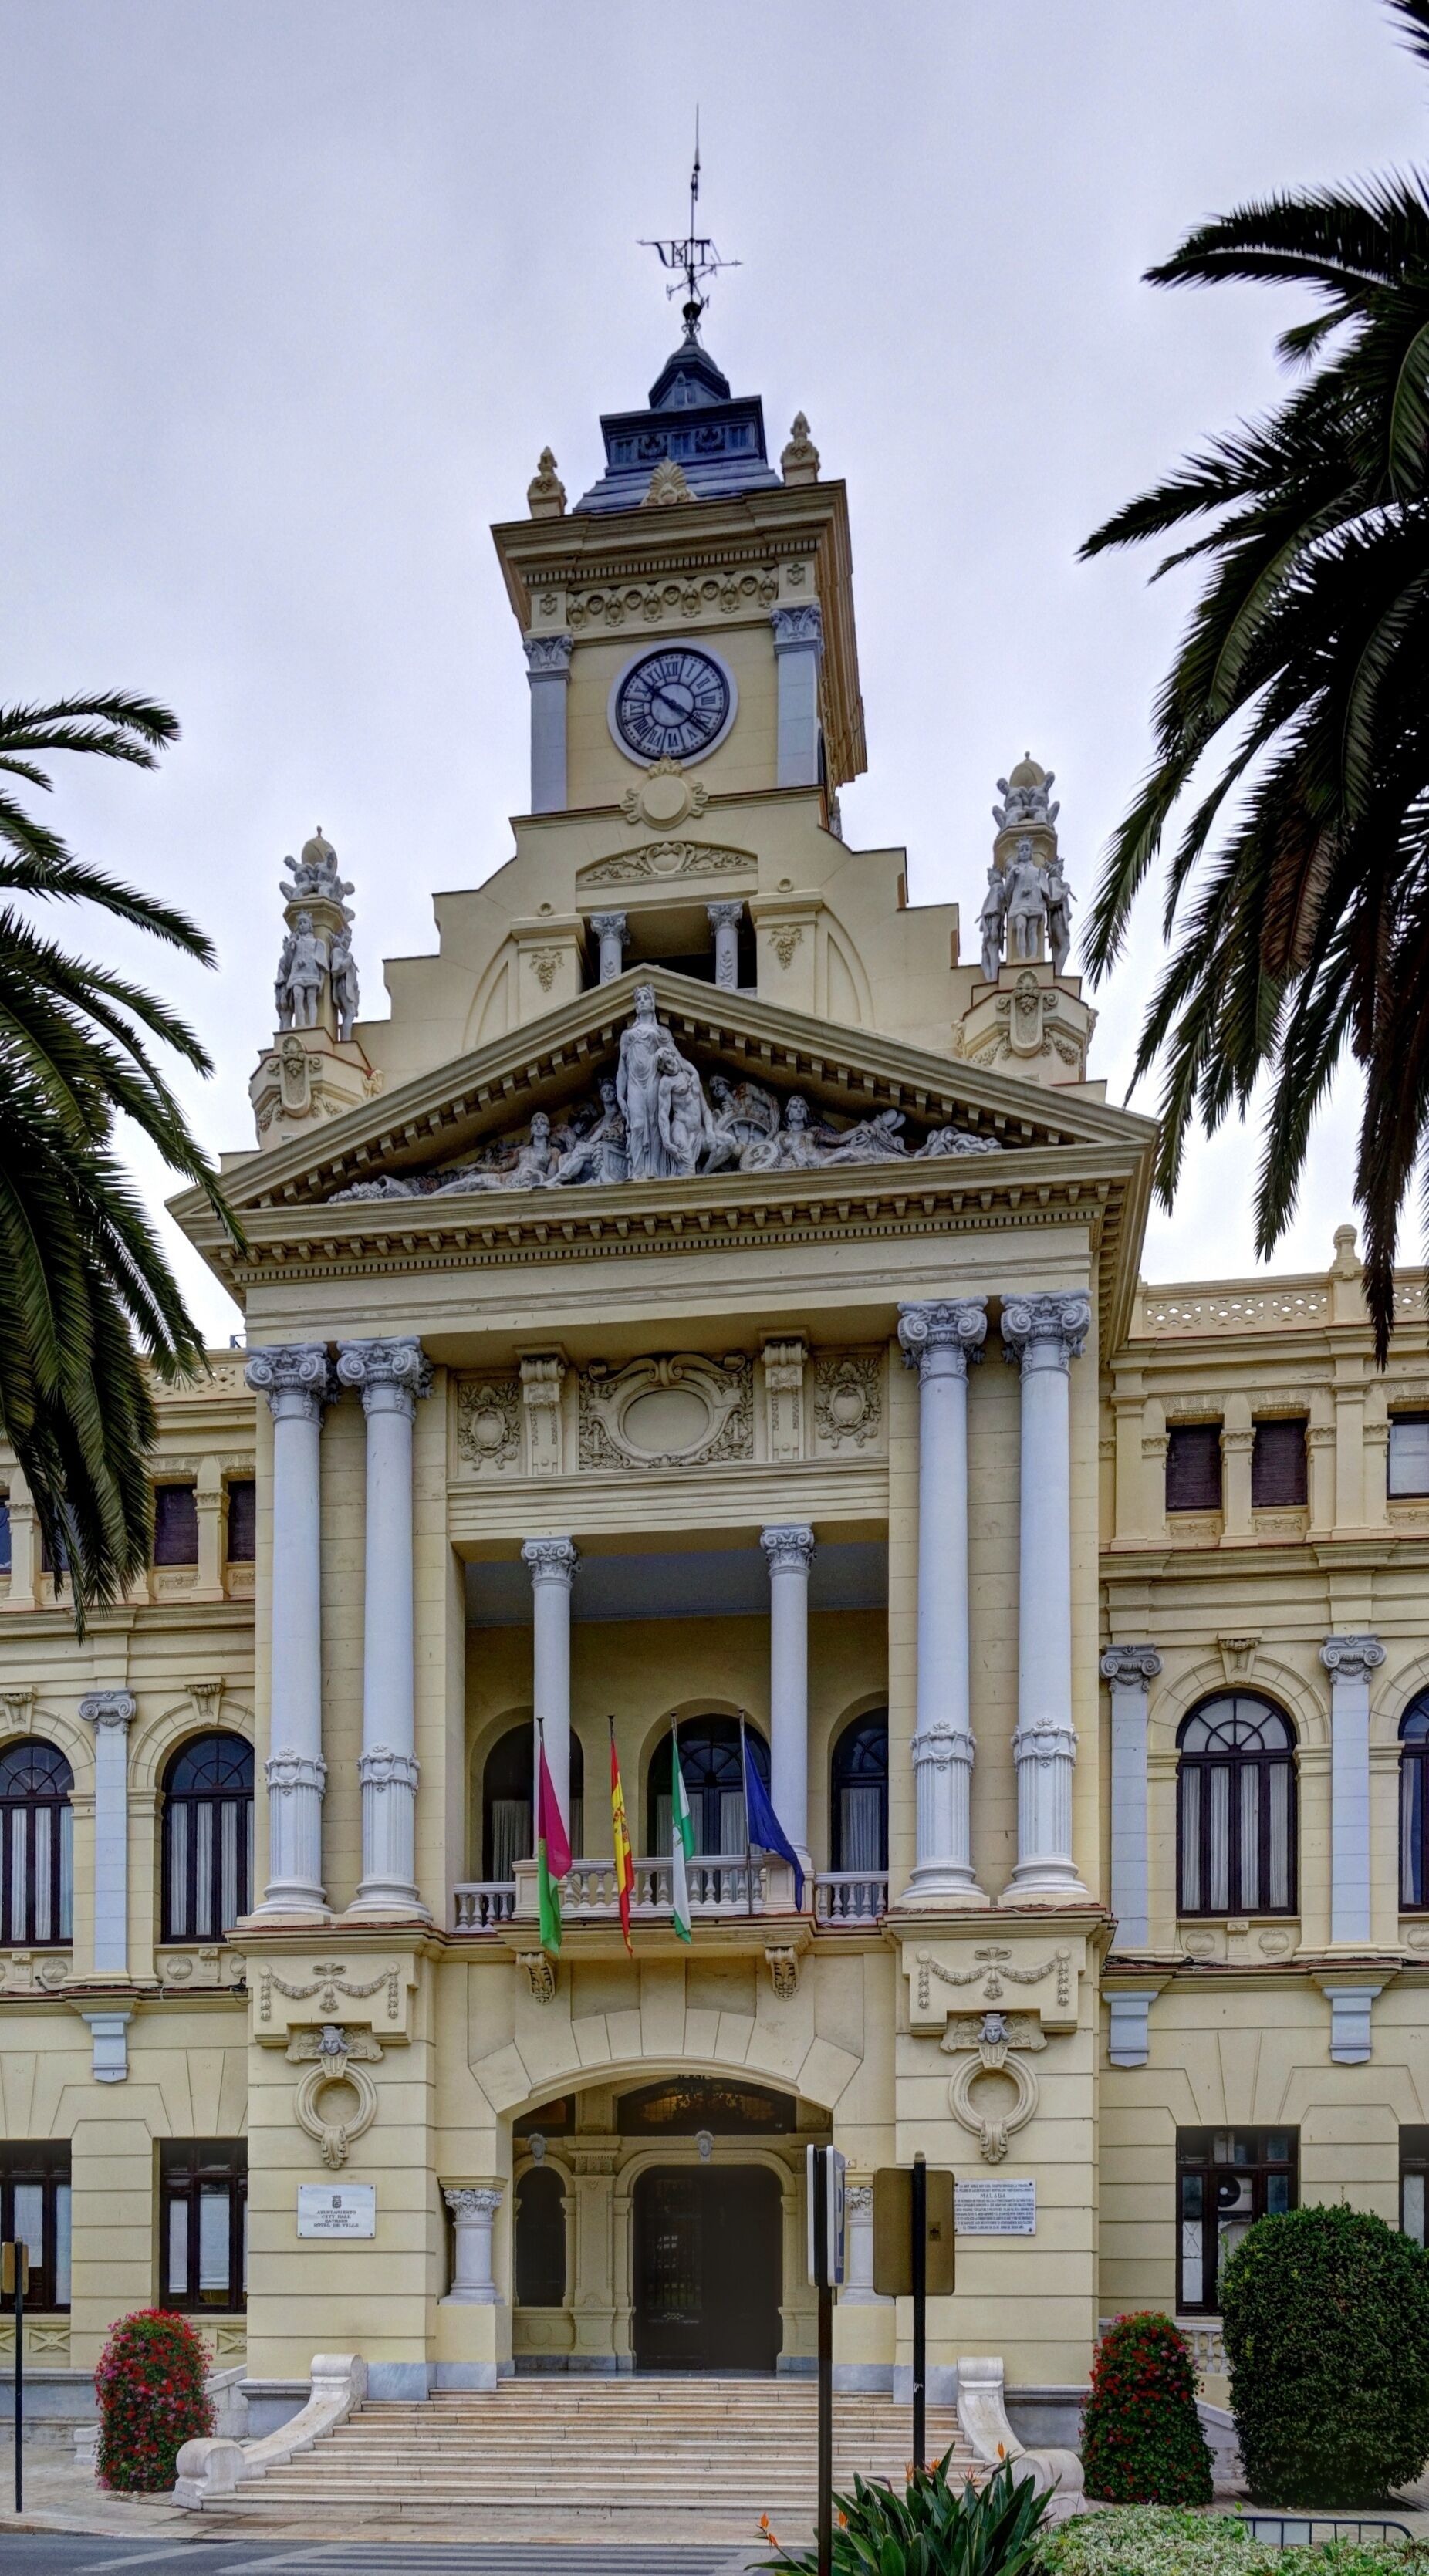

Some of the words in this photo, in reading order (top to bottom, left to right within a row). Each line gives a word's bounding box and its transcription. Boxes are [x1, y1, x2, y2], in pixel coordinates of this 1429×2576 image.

[647, 667, 663, 683] XI
[665, 661, 679, 677] XII
[686, 663, 695, 678] I
[696, 676, 710, 689] II
[701, 695, 716, 706] III
[686, 728, 698, 741] V
